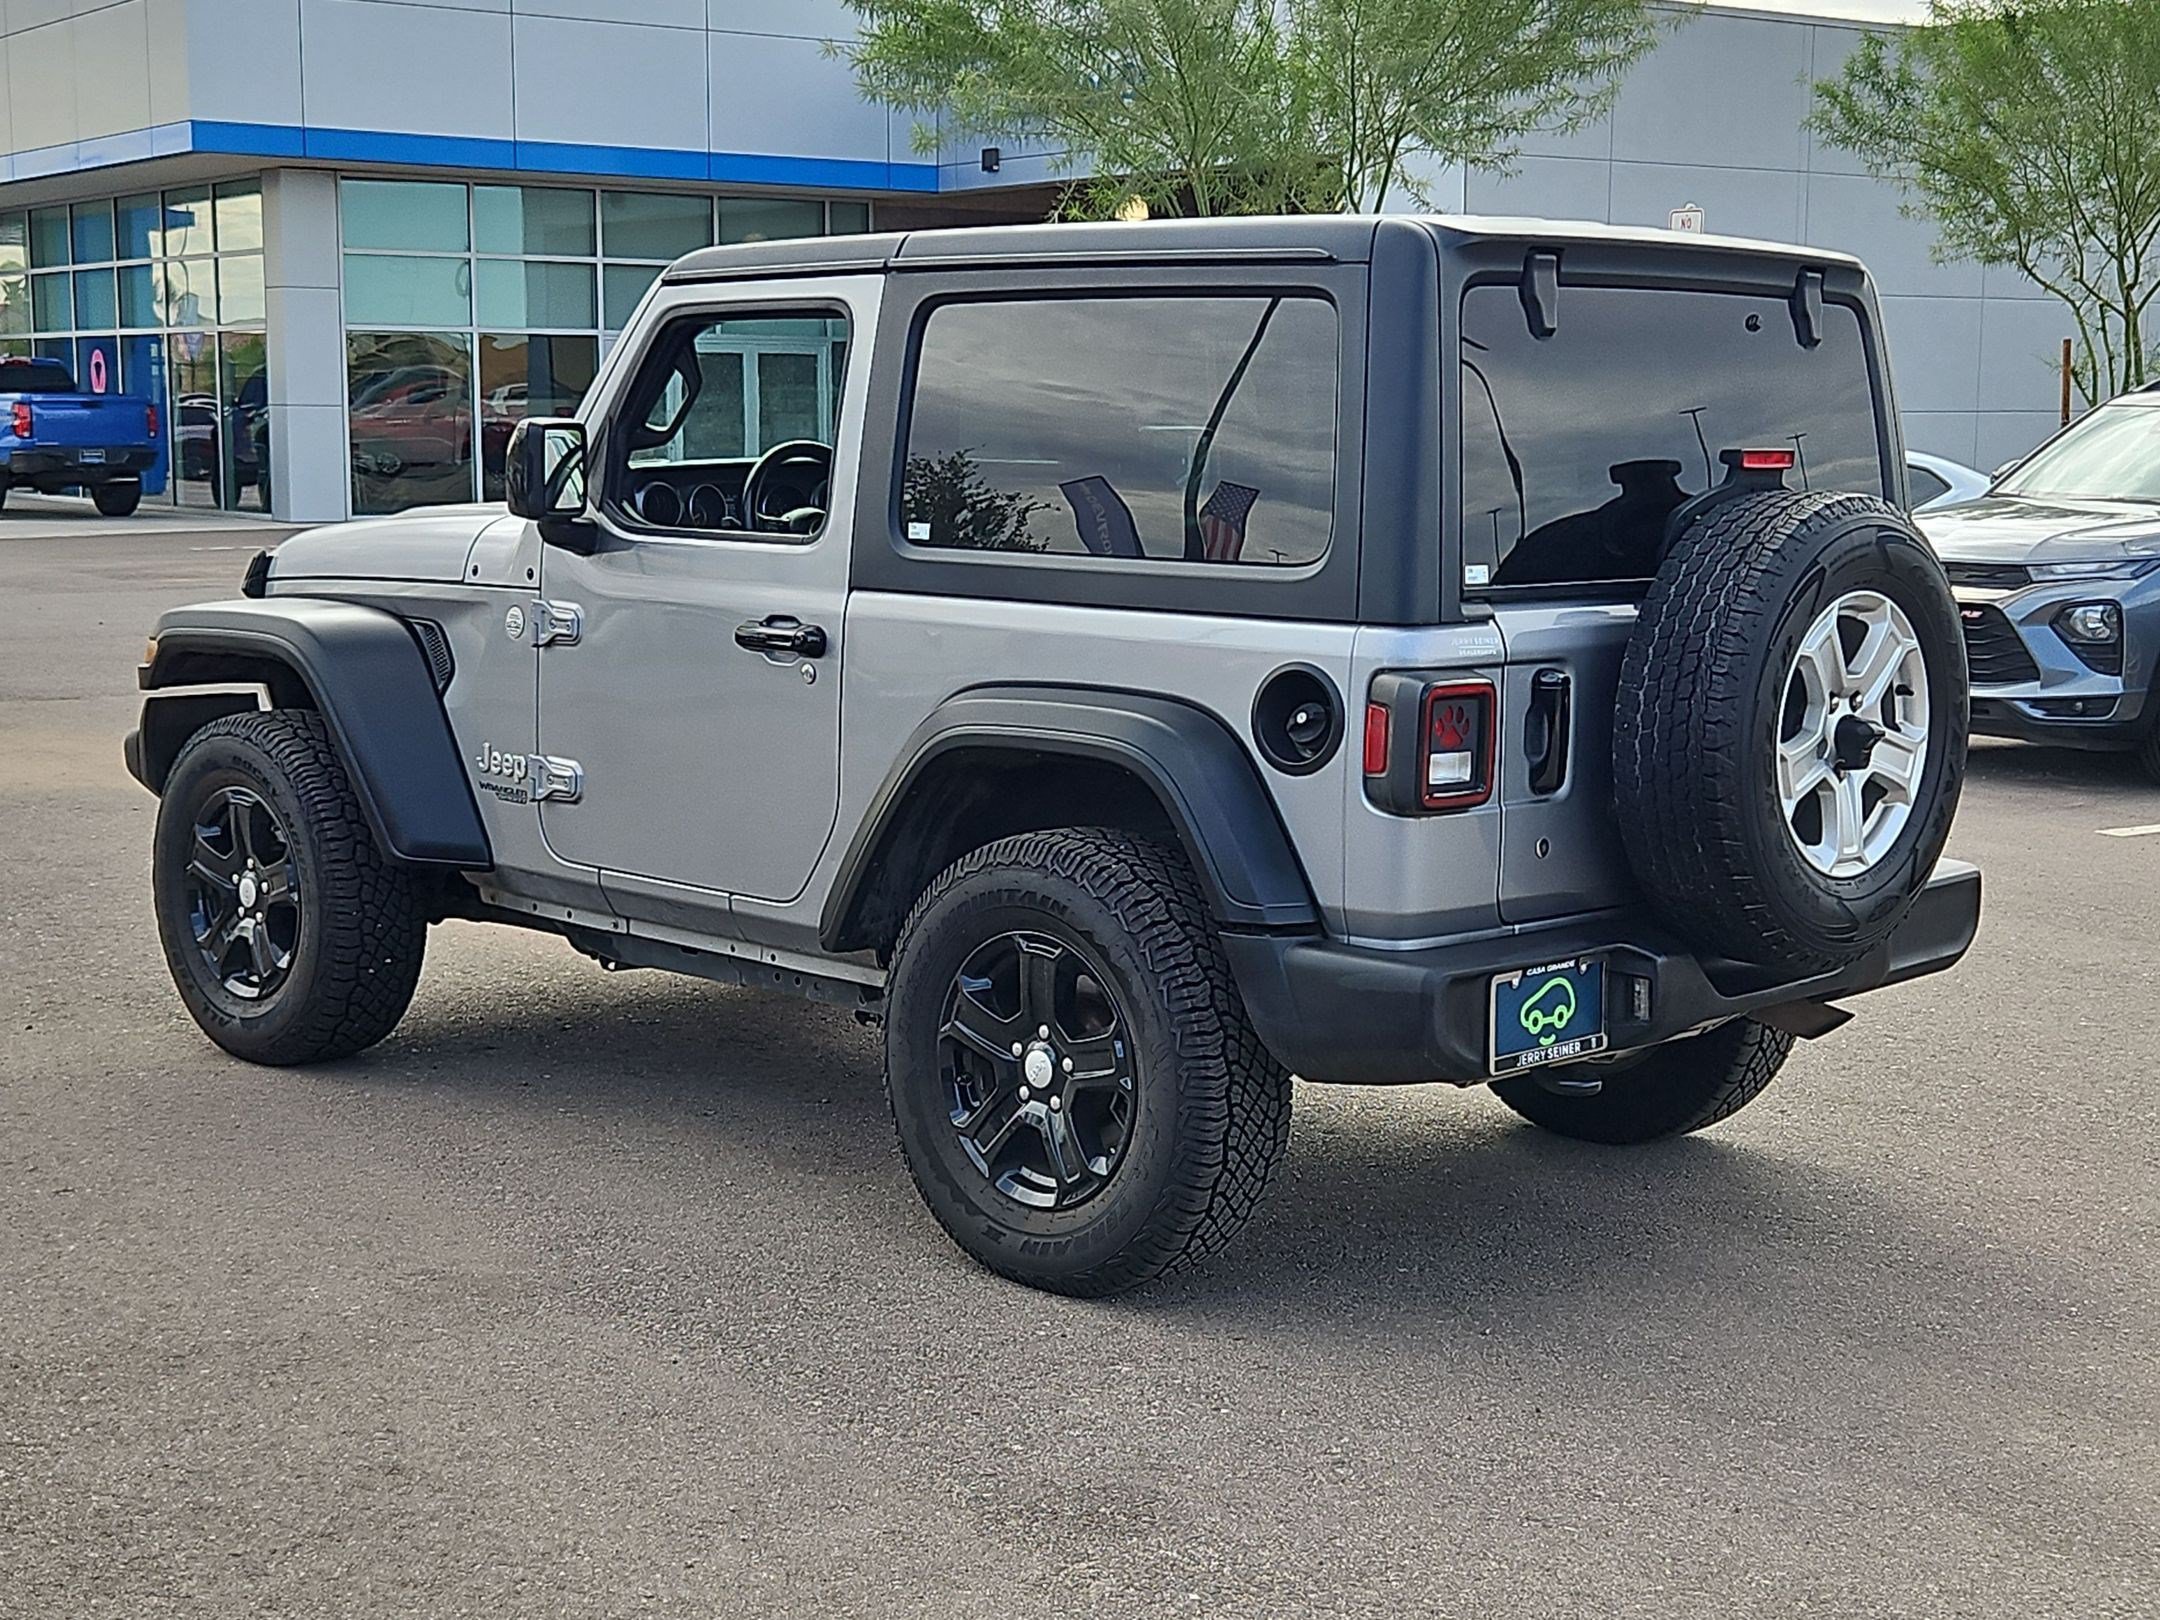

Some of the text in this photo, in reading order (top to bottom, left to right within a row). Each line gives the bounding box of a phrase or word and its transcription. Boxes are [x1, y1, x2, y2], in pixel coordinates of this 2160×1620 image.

[1680, 217, 1692, 229] NO
[475, 742, 528, 784] Jeep
[478, 780, 528, 797] WRANGLER
[1526, 959, 1576, 976] CASA GRANDE
[1516, 1041, 1581, 1066] JERRY SEINER
